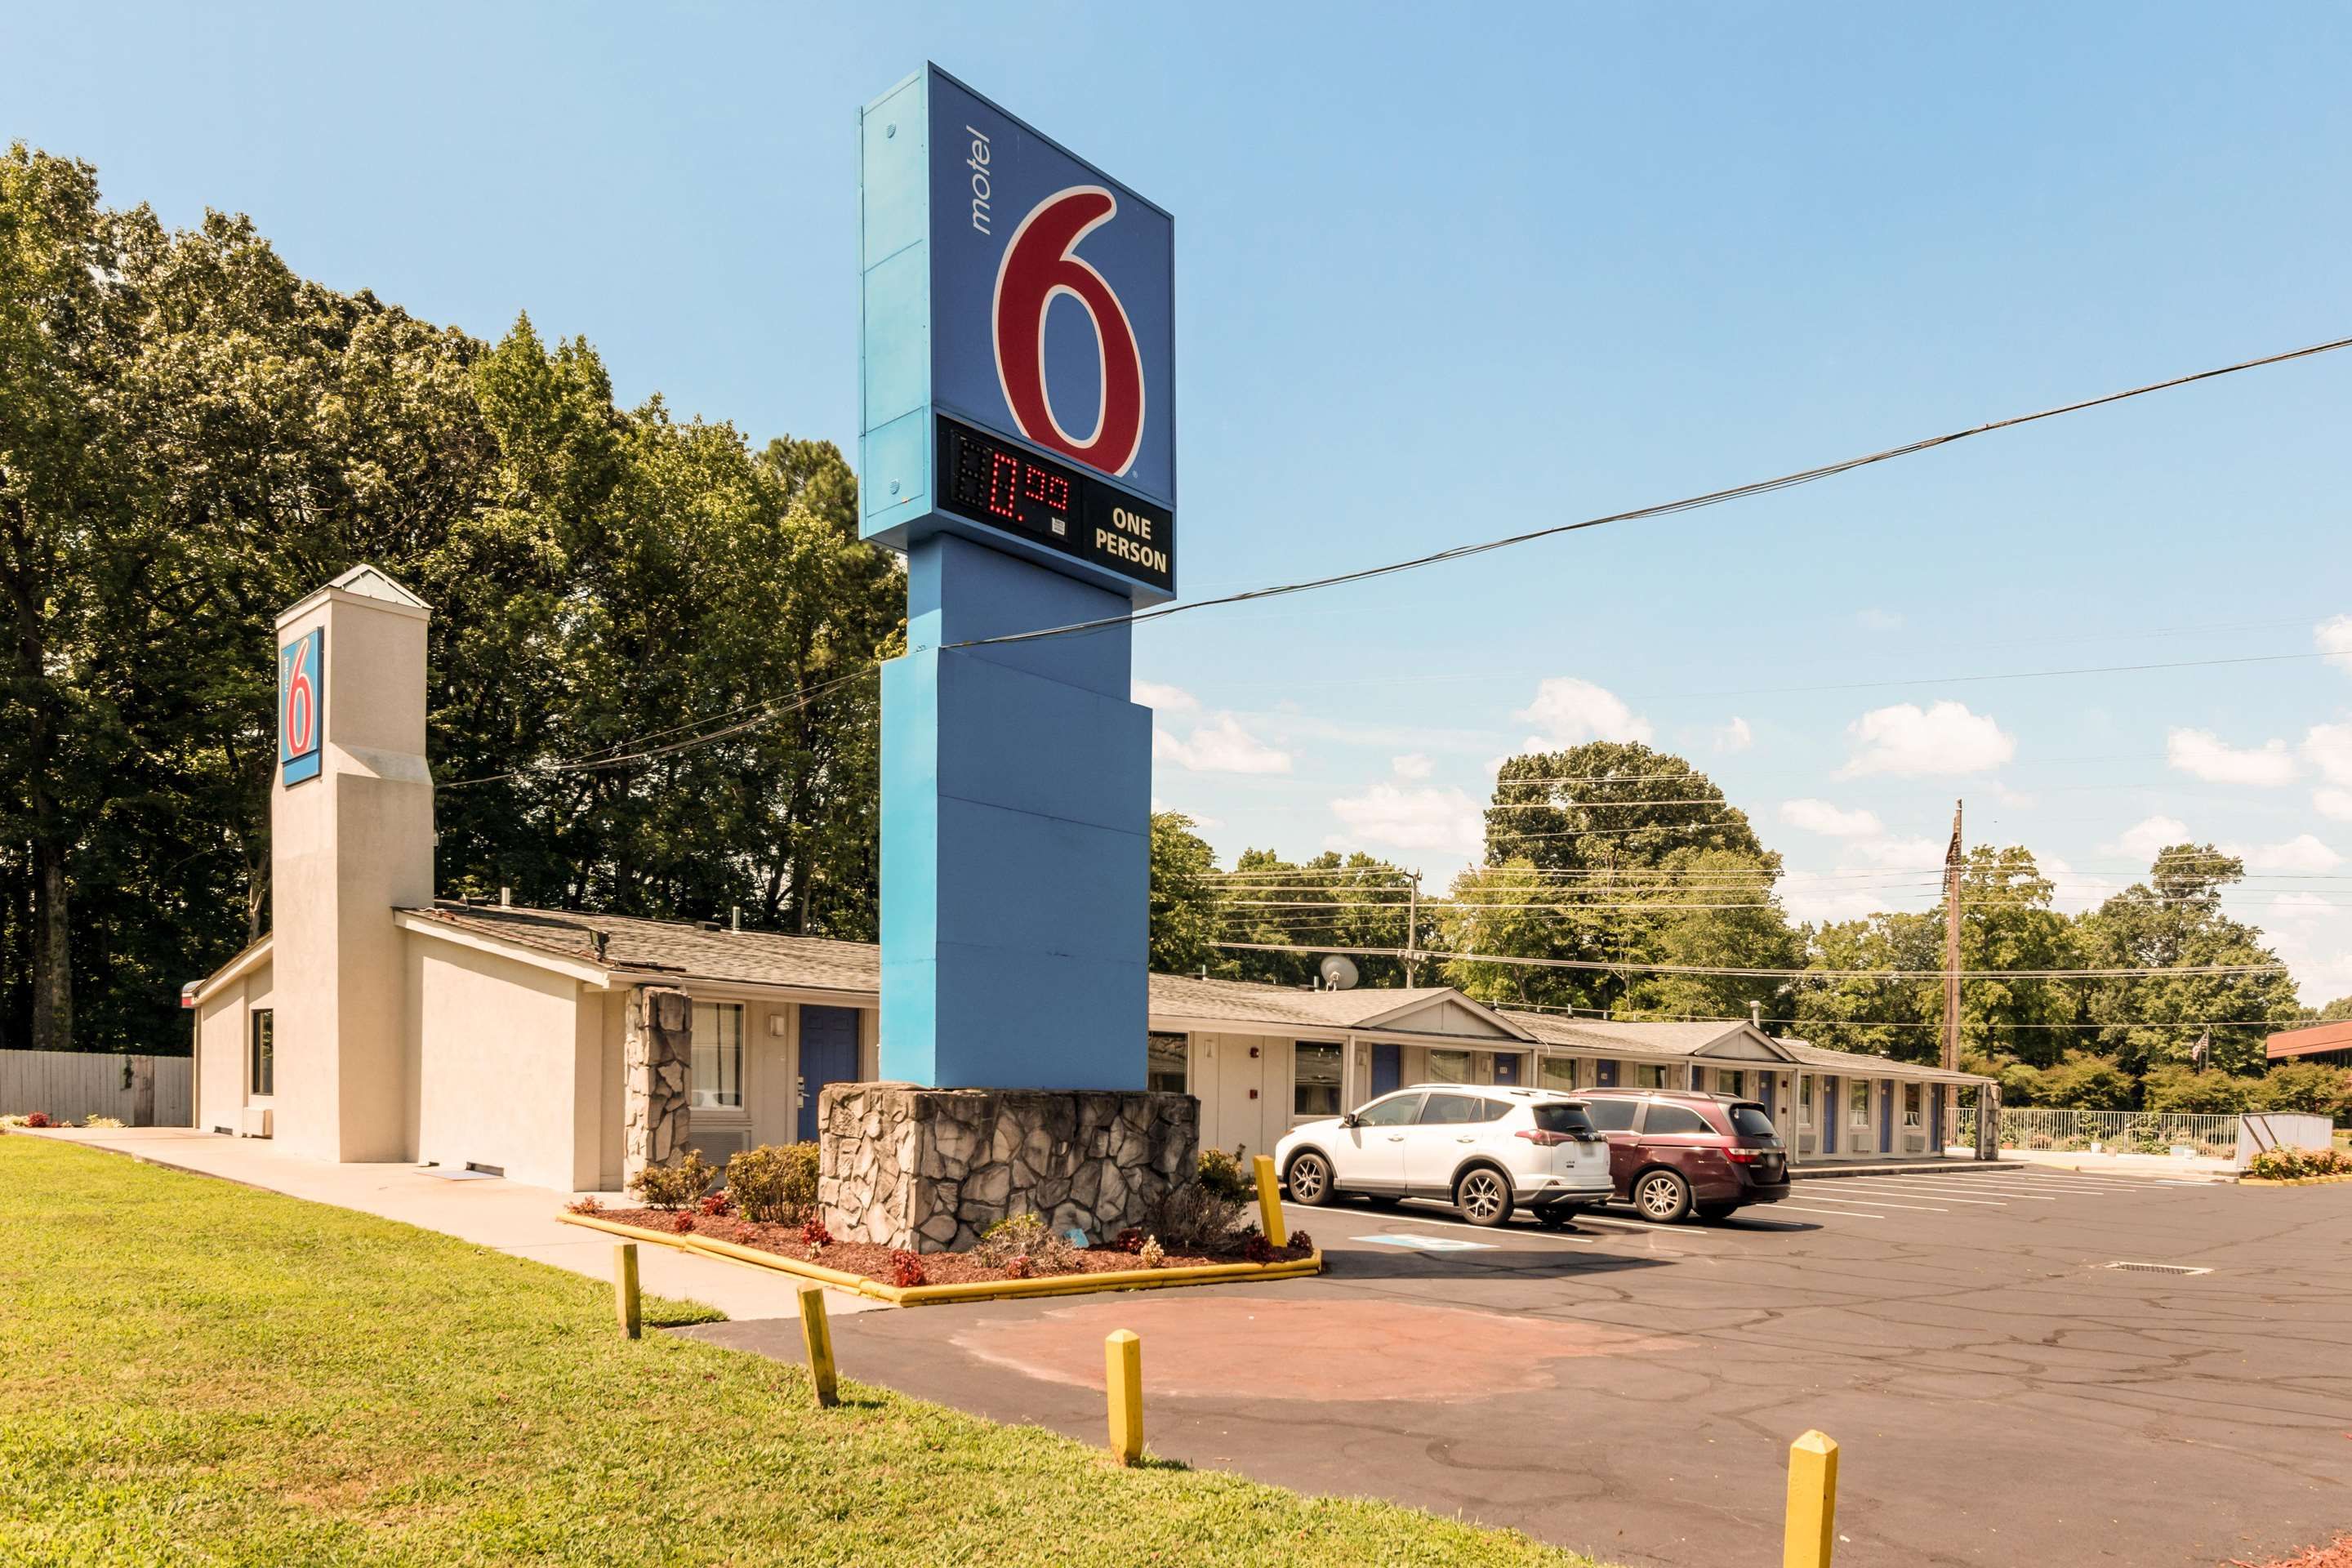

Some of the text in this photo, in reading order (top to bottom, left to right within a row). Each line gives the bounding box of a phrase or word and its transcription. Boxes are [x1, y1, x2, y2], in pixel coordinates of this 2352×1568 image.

[966, 124, 991, 235] motel
[991, 185, 1145, 478] 6
[1096, 528, 1167, 574] PERSON
[1112, 507, 1152, 541] ONE
[287, 637, 314, 757] 6
